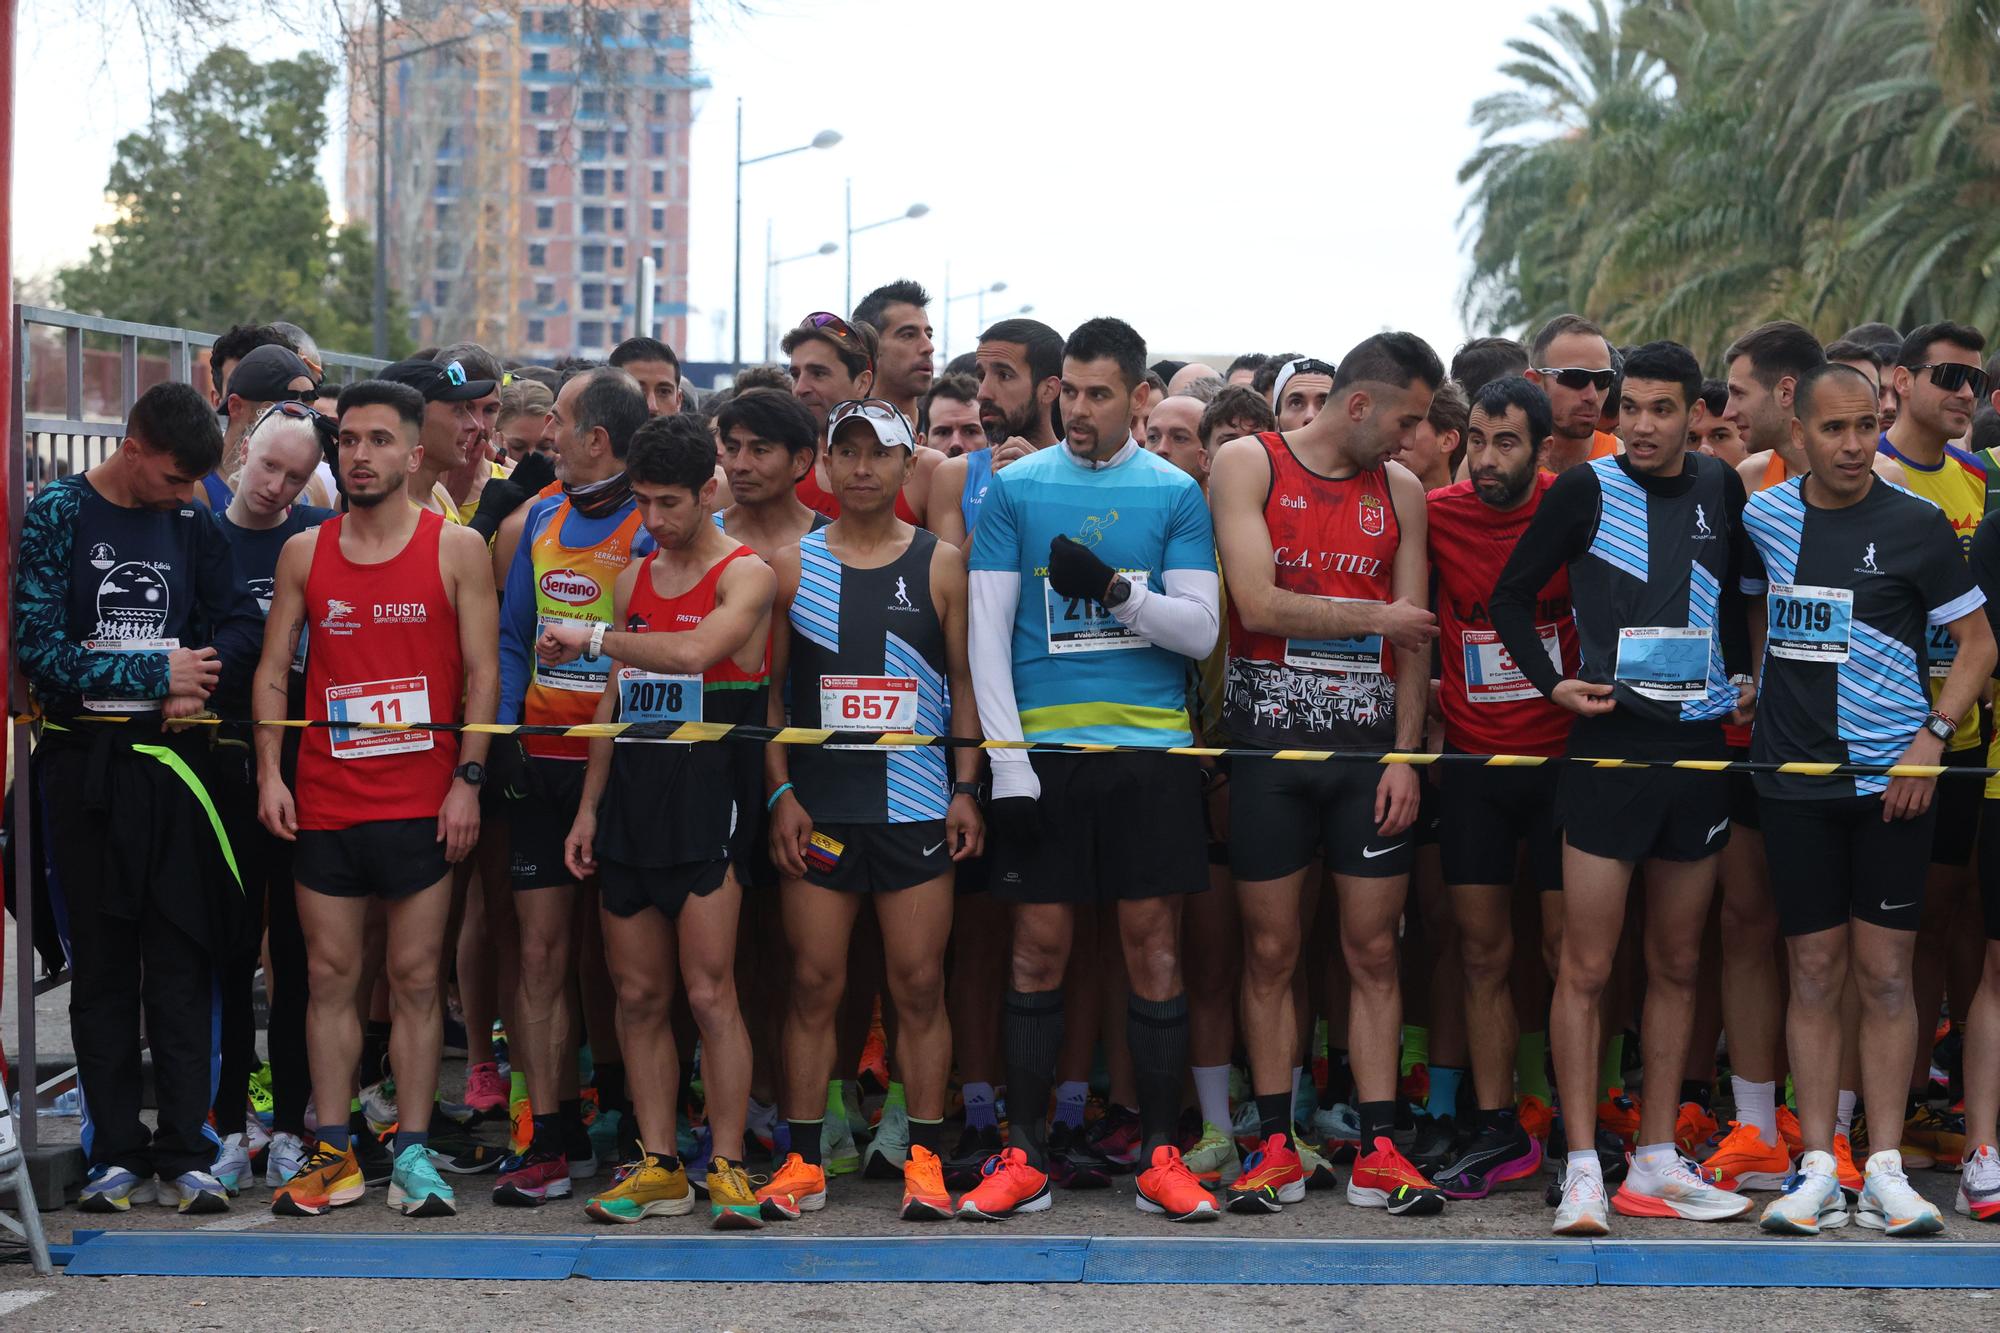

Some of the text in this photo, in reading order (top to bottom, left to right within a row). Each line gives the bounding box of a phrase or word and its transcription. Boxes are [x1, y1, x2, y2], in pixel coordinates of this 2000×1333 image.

[594, 551, 628, 564] SERRANO
[1274, 546, 1381, 577] C.A. UTIEL
[543, 575, 596, 597] Serrano
[373, 603, 427, 617] D FUSTA
[574, 611, 584, 619] de
[585, 612, 602, 622] Hoy
[1775, 598, 1831, 632] 2019
[1640, 681, 1683, 690] #ValènciaCorre
[629, 682, 683, 713] 2078
[842, 695, 900, 720] 657
[370, 698, 403, 725] 11
